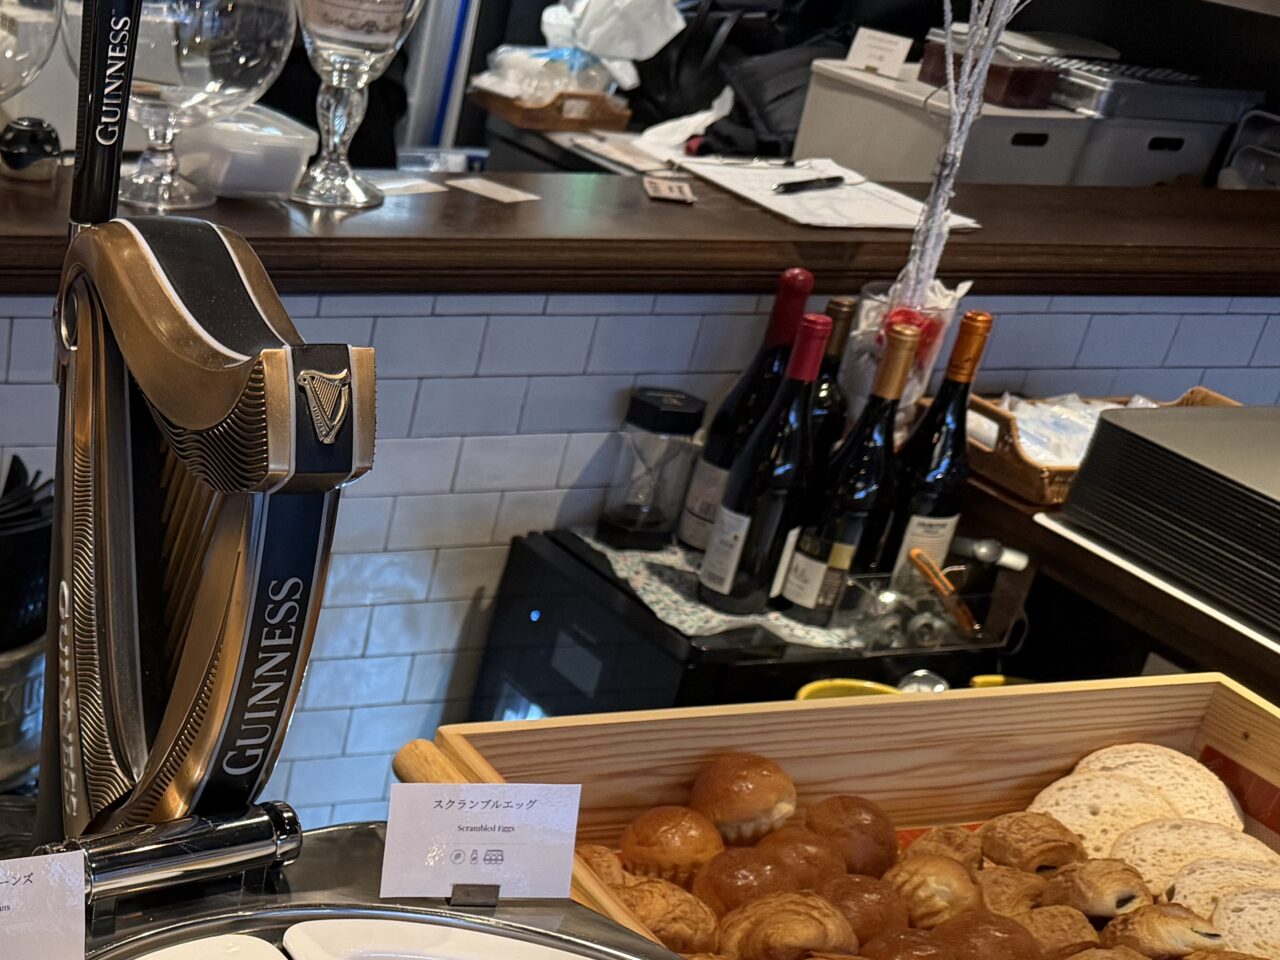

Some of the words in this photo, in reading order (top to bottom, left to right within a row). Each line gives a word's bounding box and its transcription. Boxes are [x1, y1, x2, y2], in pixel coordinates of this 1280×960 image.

[95, 16, 131, 146] GUINNESS
[222, 576, 304, 776] GUINNESS
[433, 799, 538, 810] スクランブルエッグ
[457, 824, 496, 832] Scrambled
[497, 824, 516, 833] Eggs
